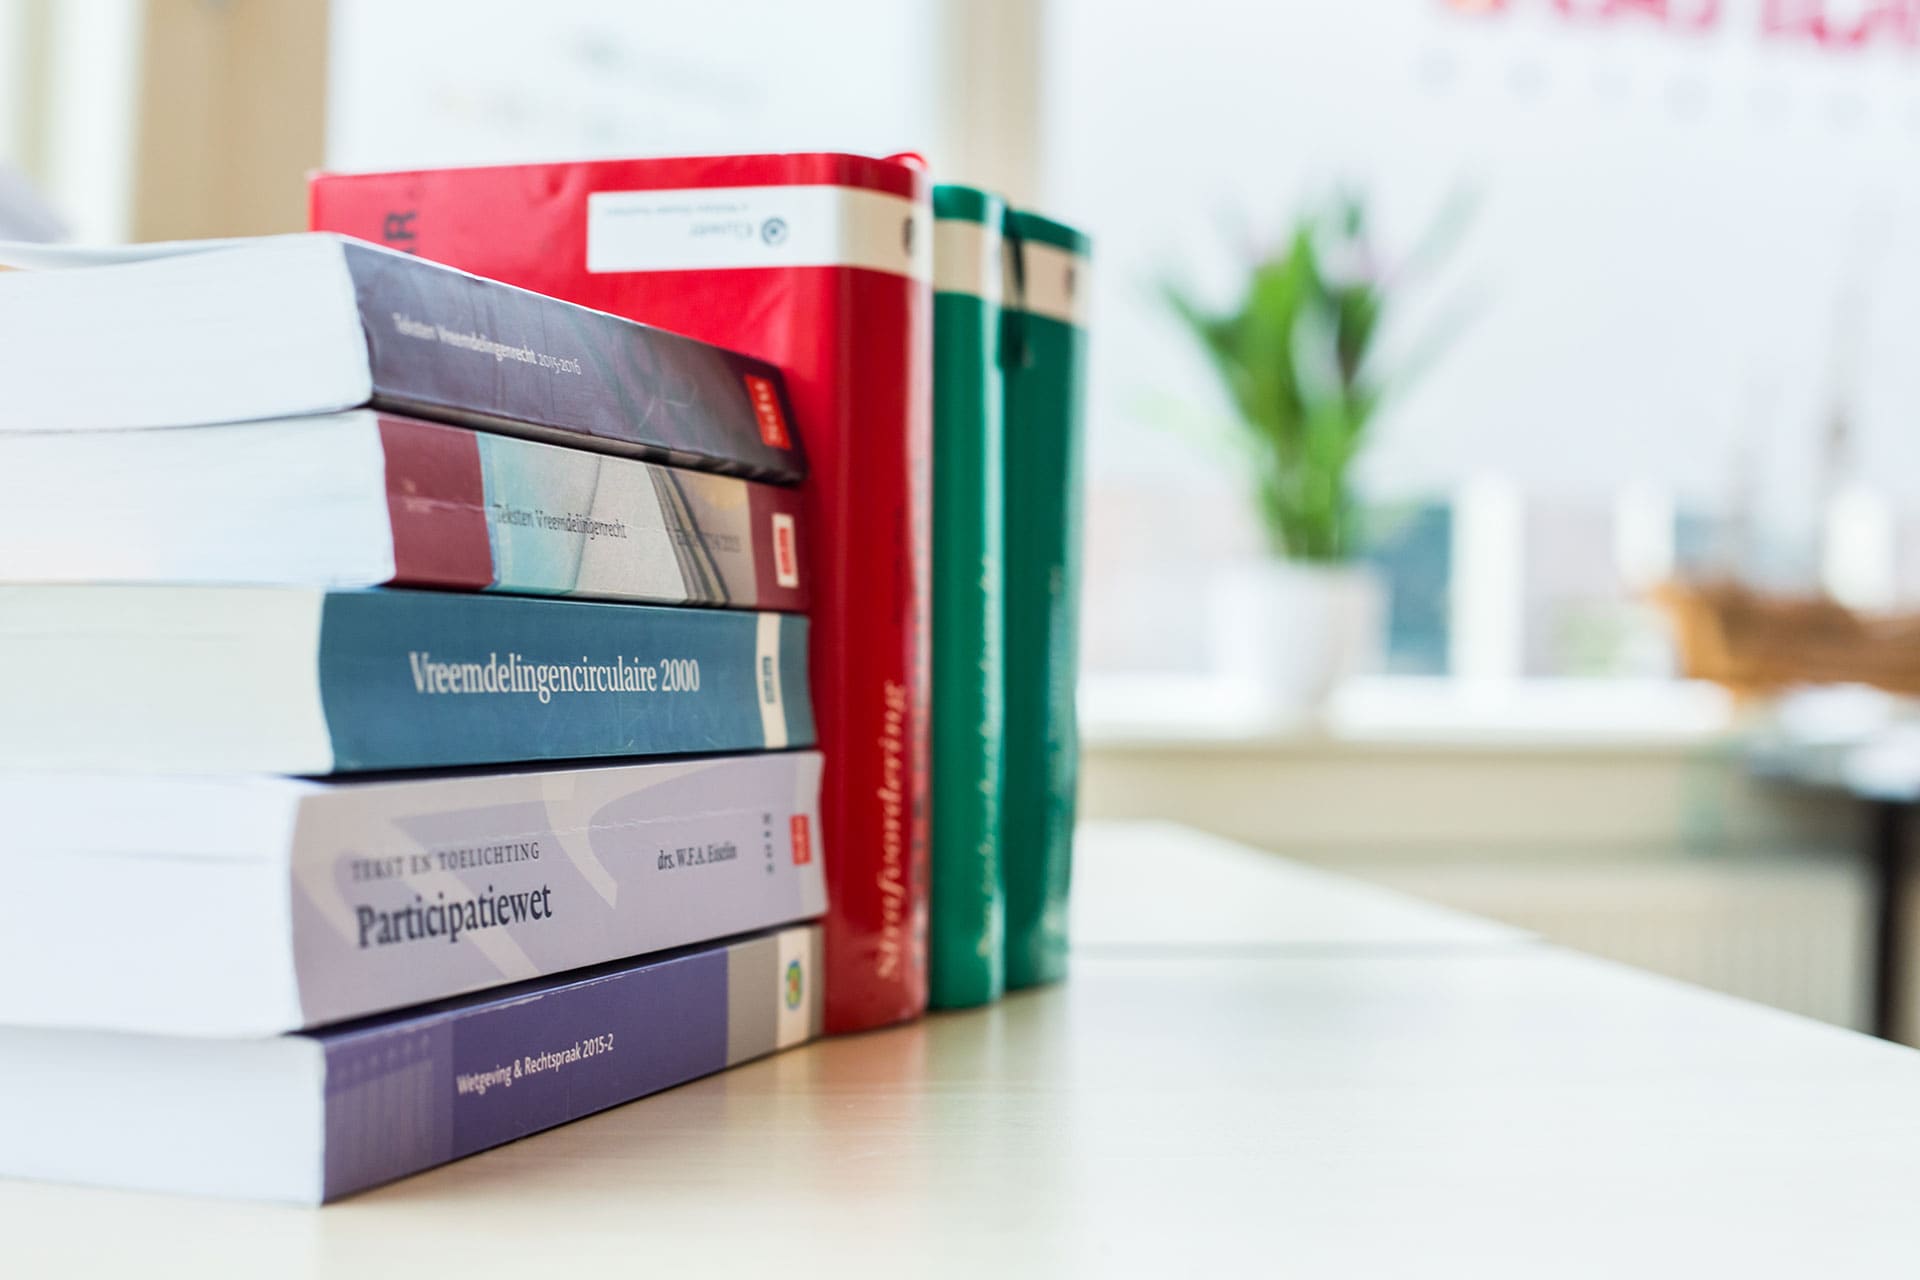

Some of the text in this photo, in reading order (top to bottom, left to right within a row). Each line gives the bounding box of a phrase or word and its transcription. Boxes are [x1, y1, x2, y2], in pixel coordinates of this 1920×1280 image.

[538, 353, 582, 376] 2015-2016
[534, 509, 628, 541] Vreemdelingenrecht
[408, 650, 700, 704] Vreemdelingencirculaire 2000
[438, 841, 541, 872] TOELICHTING
[657, 849, 676, 871] drs.
[355, 883, 554, 951] Participatiewet
[455, 1032, 615, 1096] Wetgeving & Rechtspraak 2015-2
